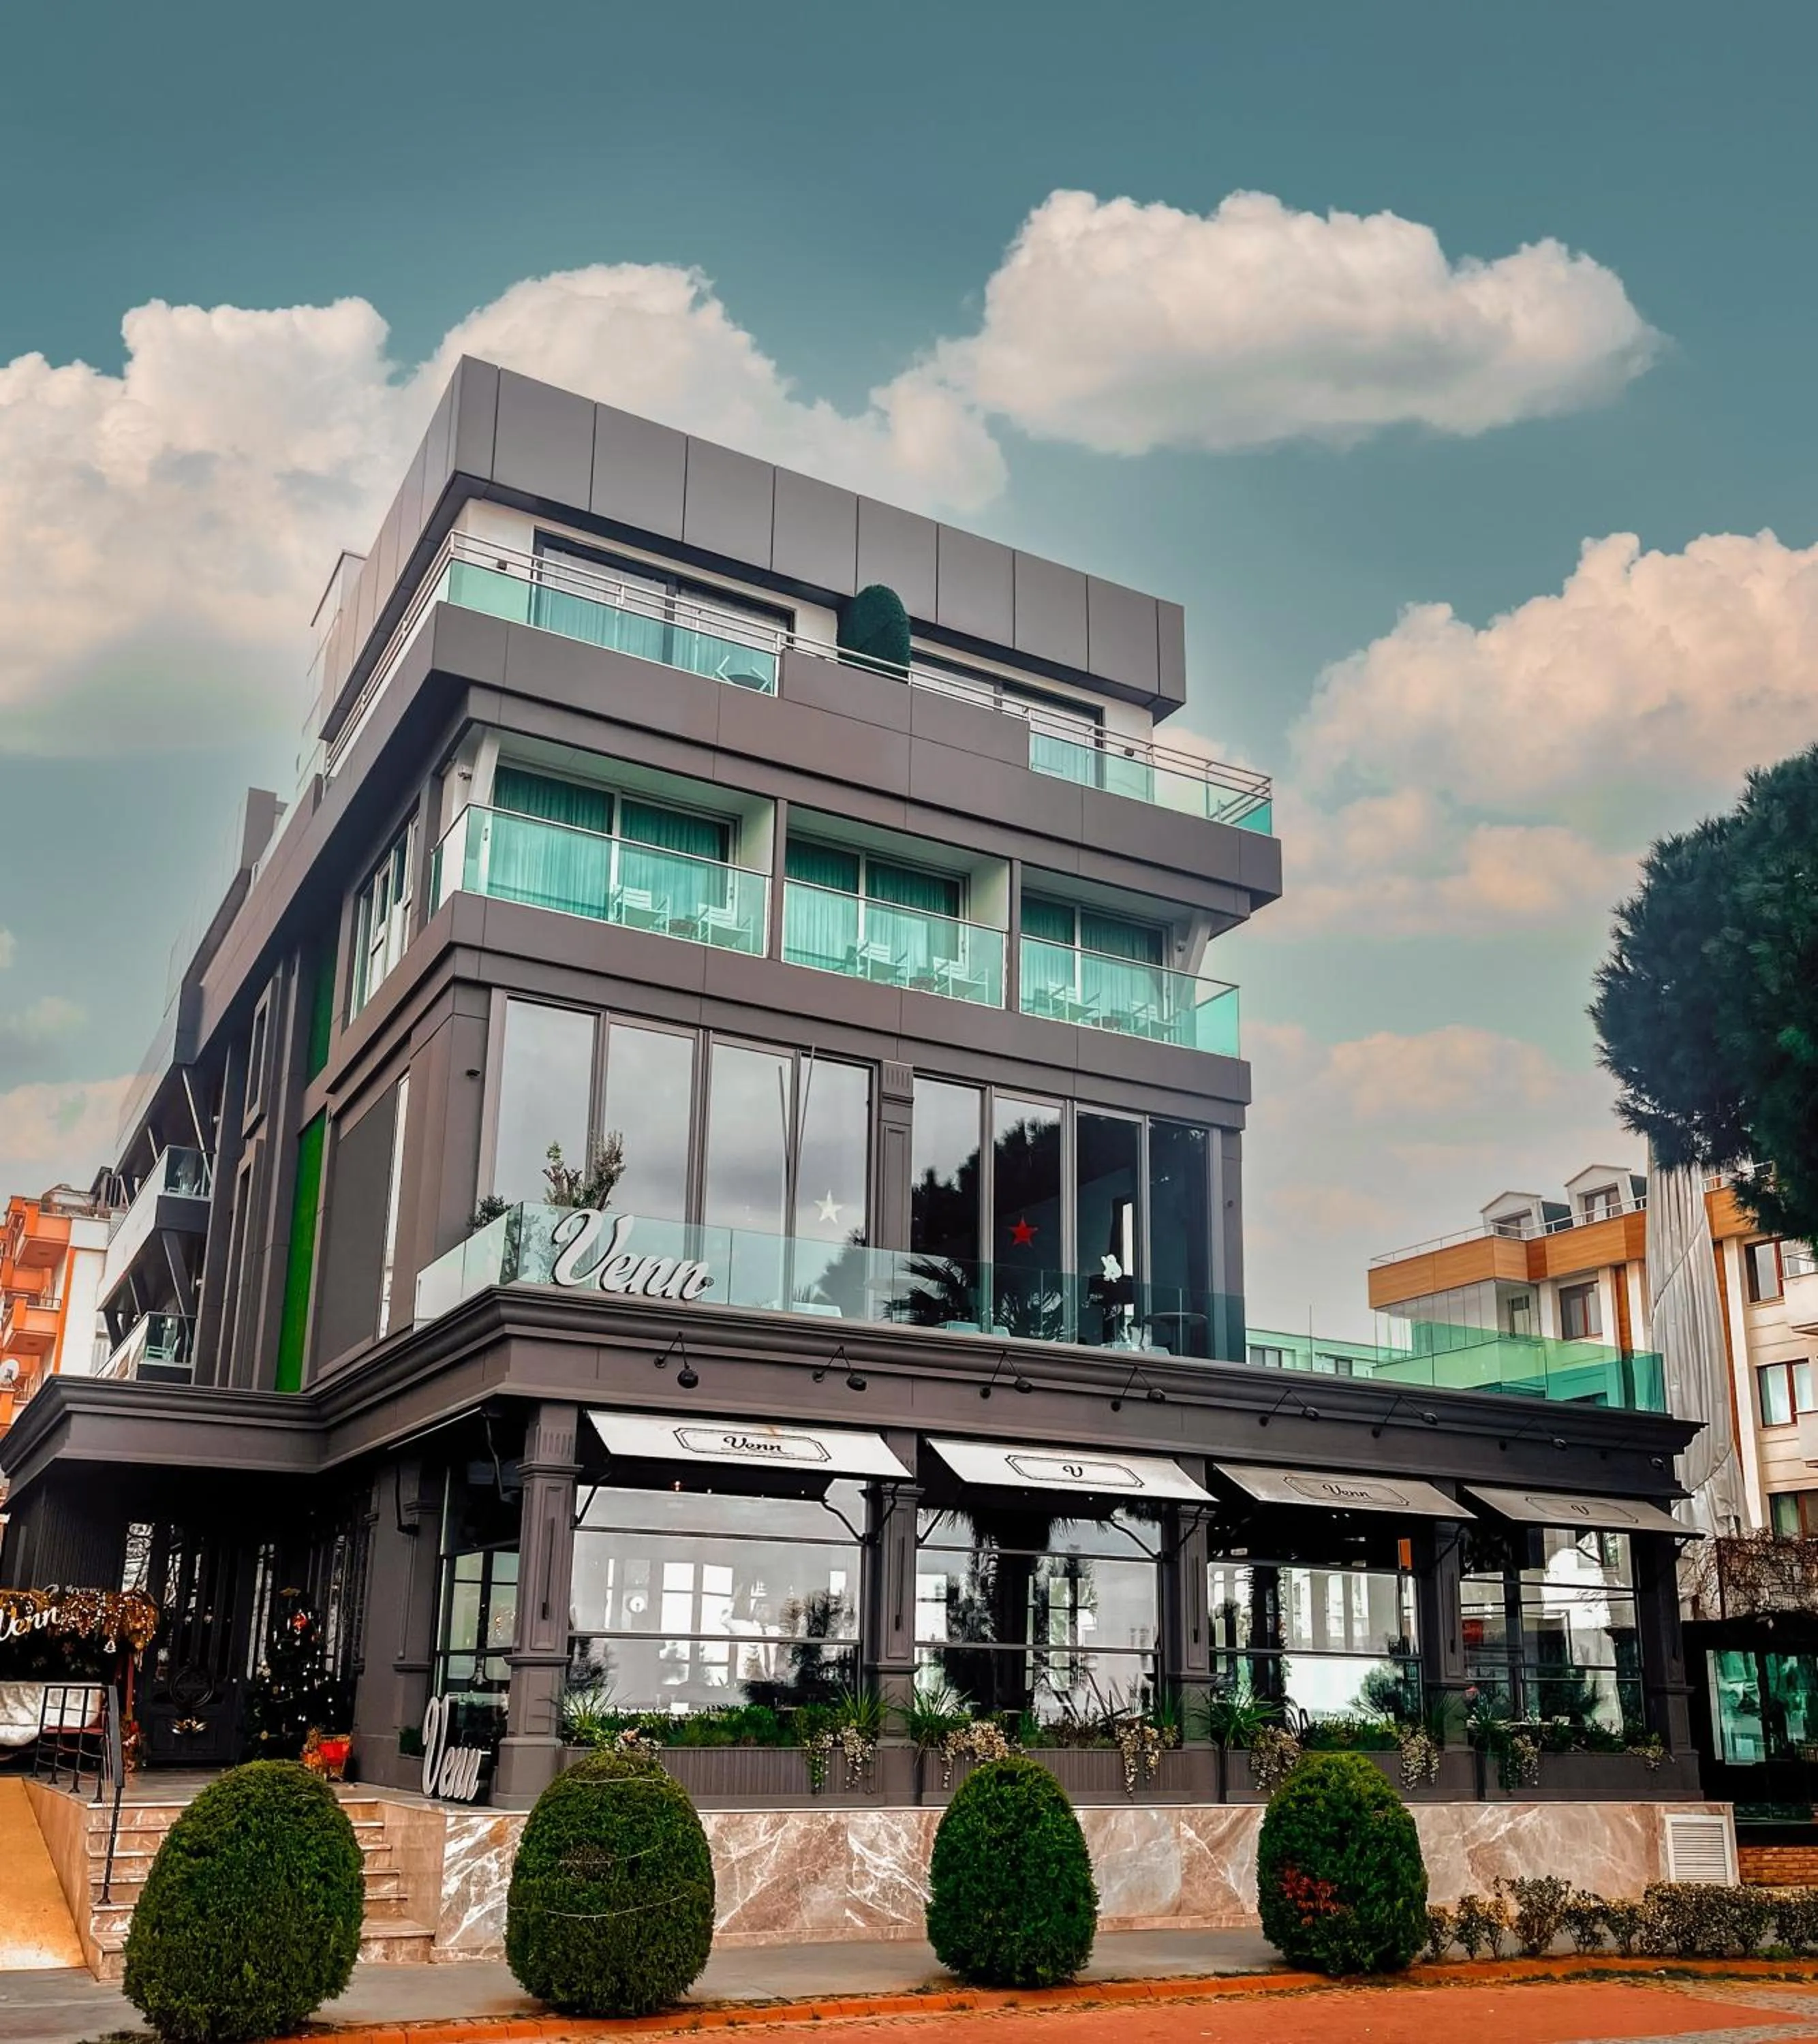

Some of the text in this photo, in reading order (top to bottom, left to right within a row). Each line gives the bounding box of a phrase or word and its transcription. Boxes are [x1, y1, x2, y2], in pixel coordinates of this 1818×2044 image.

[551, 1208, 714, 1301] Venn
[722, 1436, 782, 1453] Venn
[1062, 1465, 1083, 1478] V
[1322, 1485, 1372, 1499] Venn
[422, 1694, 482, 1801] Venn
